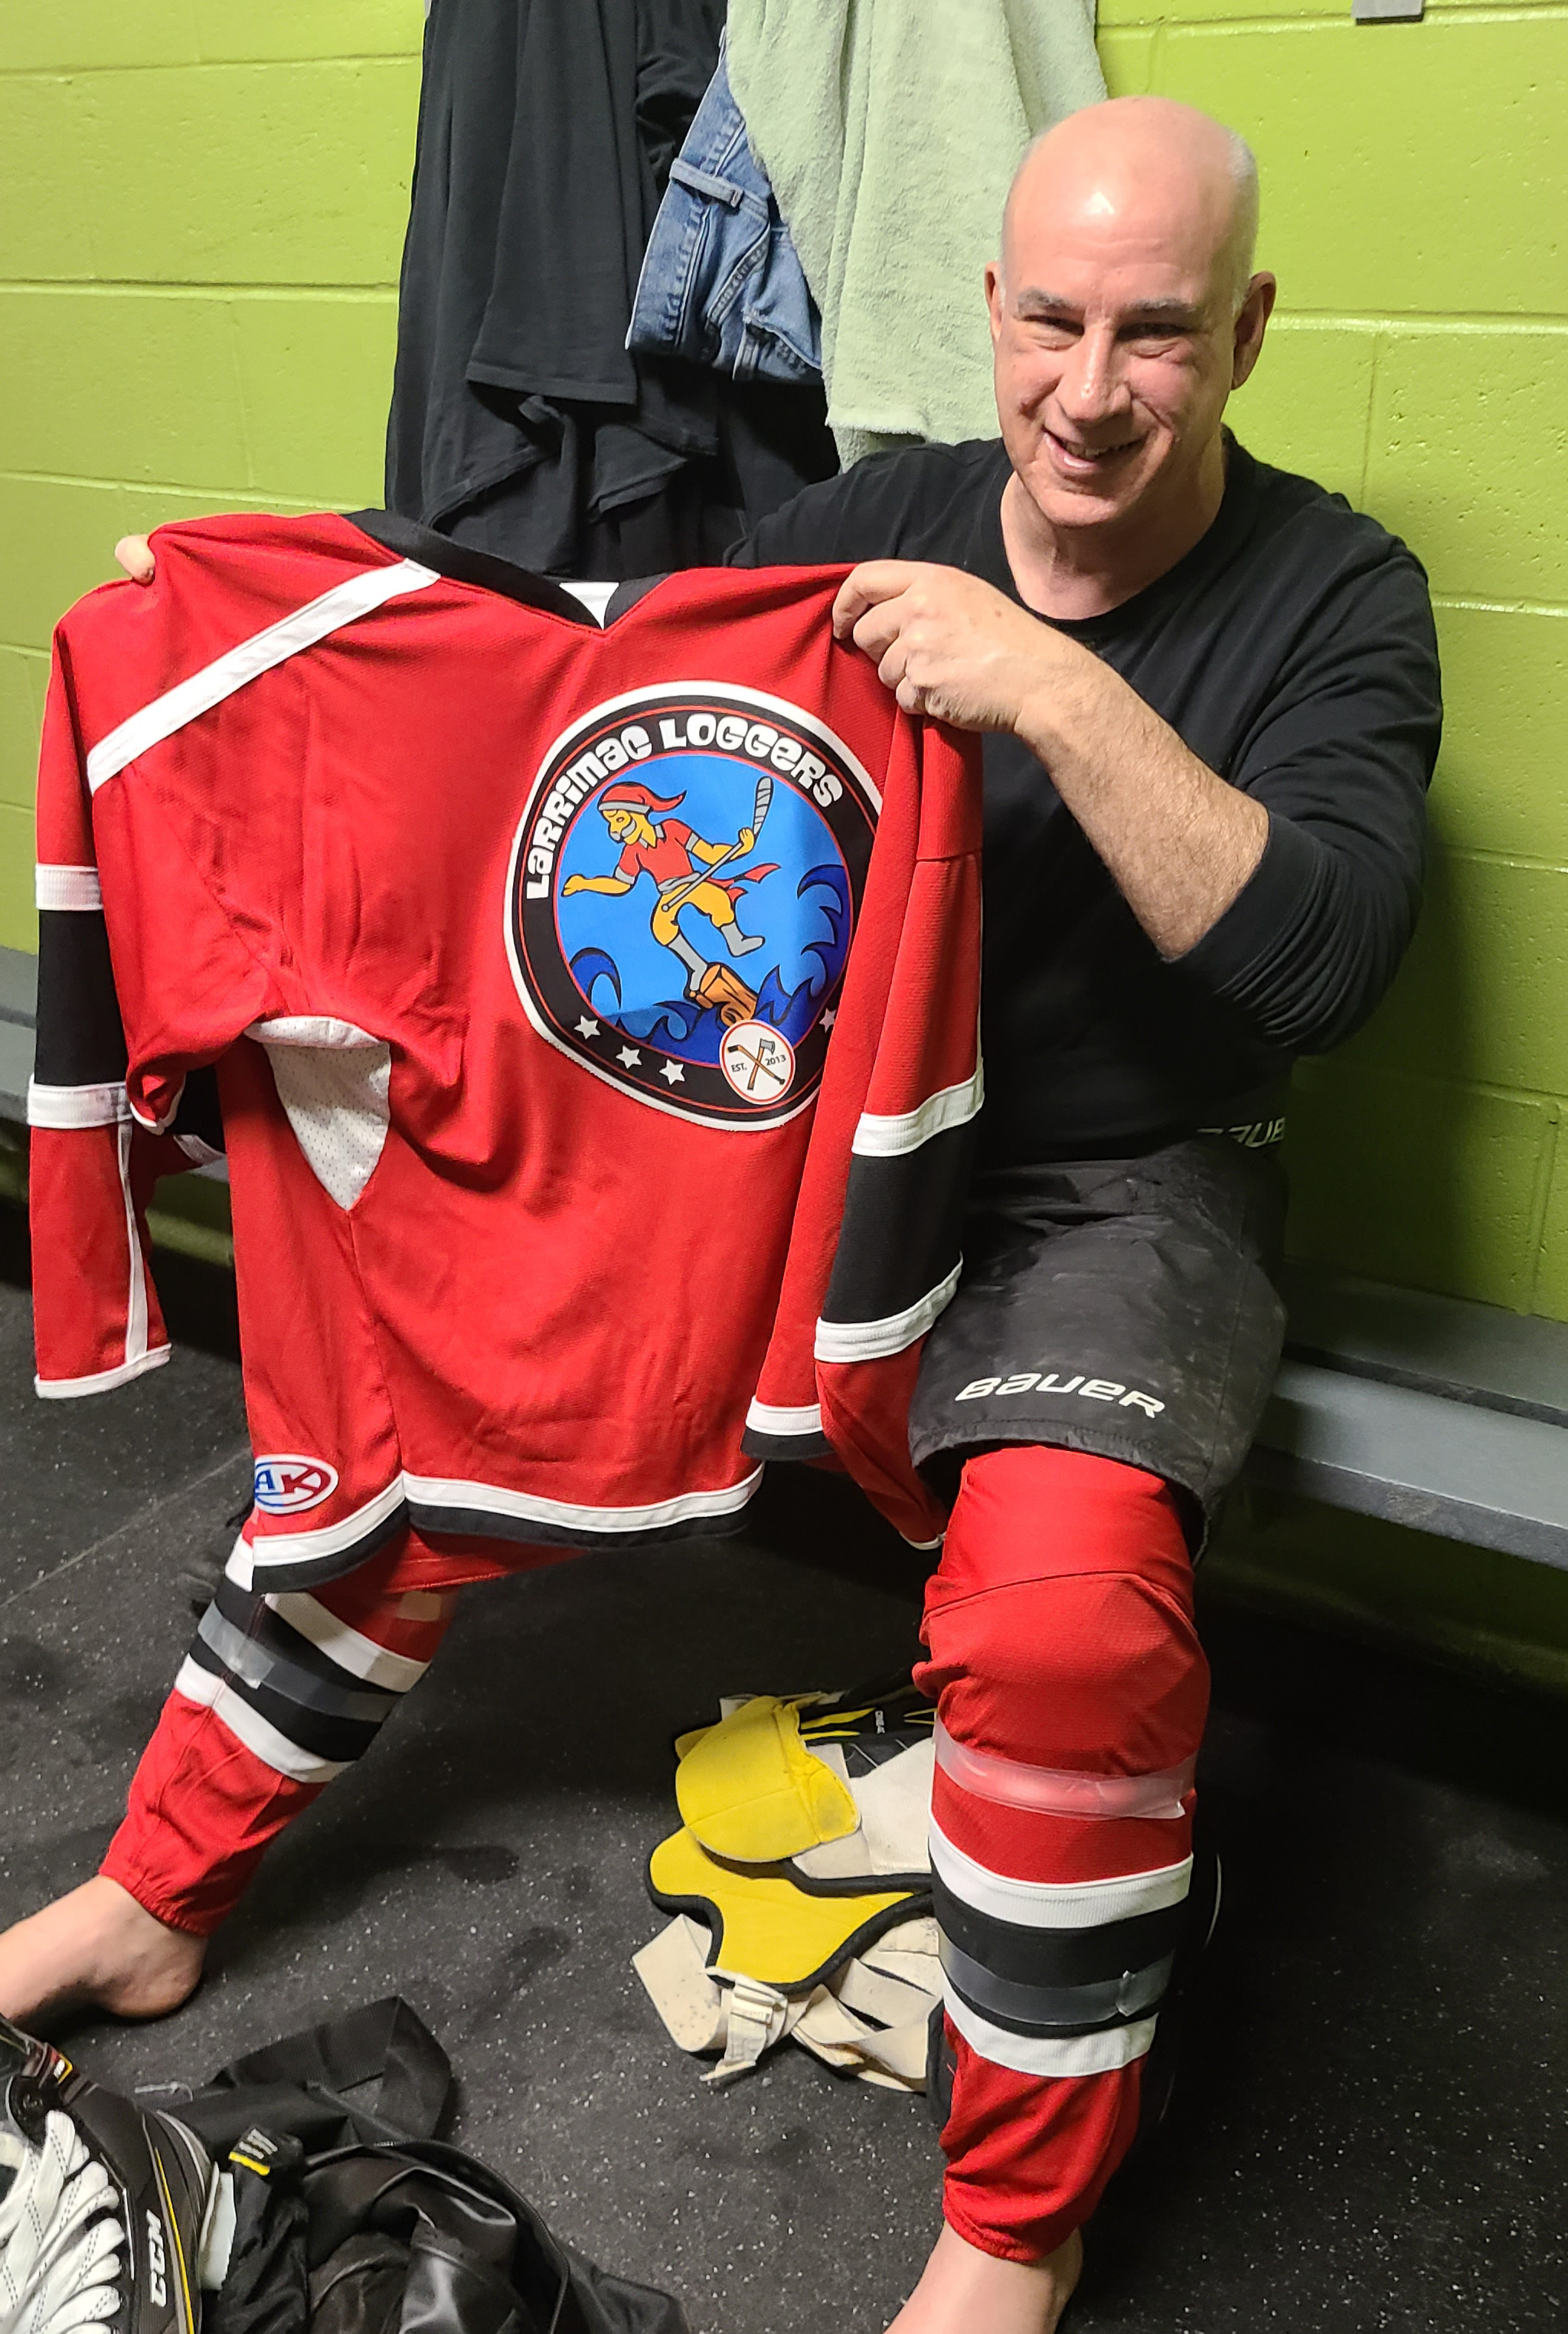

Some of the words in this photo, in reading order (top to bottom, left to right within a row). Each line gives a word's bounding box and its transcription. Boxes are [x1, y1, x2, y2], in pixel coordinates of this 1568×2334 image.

[730, 1063, 747, 1073] EST.
[765, 1054, 787, 1066] 2013
[145, 2208, 167, 2307] CCM
